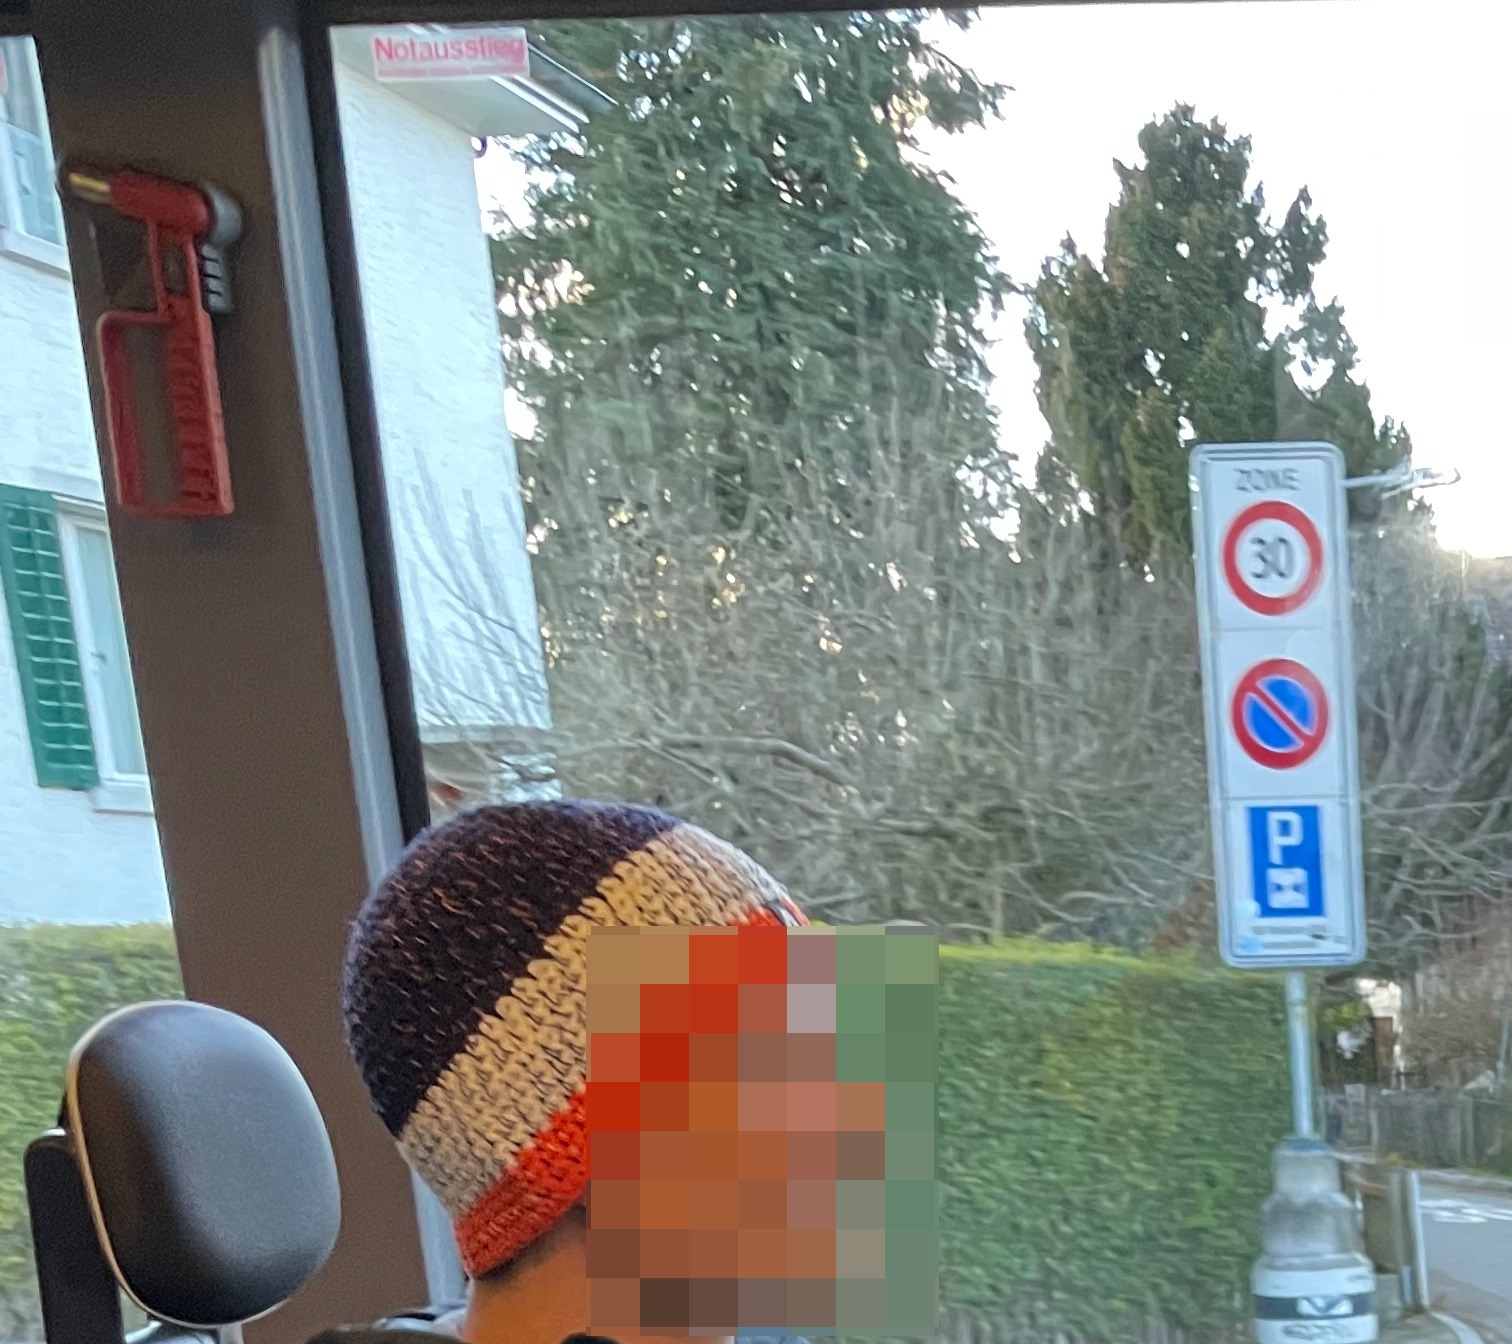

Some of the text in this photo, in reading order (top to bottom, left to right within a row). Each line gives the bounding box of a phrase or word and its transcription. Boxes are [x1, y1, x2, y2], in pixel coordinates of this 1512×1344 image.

[374, 35, 526, 62] Notausstieg
[1233, 467, 1300, 492] ZONE
[1250, 536, 1295, 579] 30
[1266, 810, 1304, 865] P
